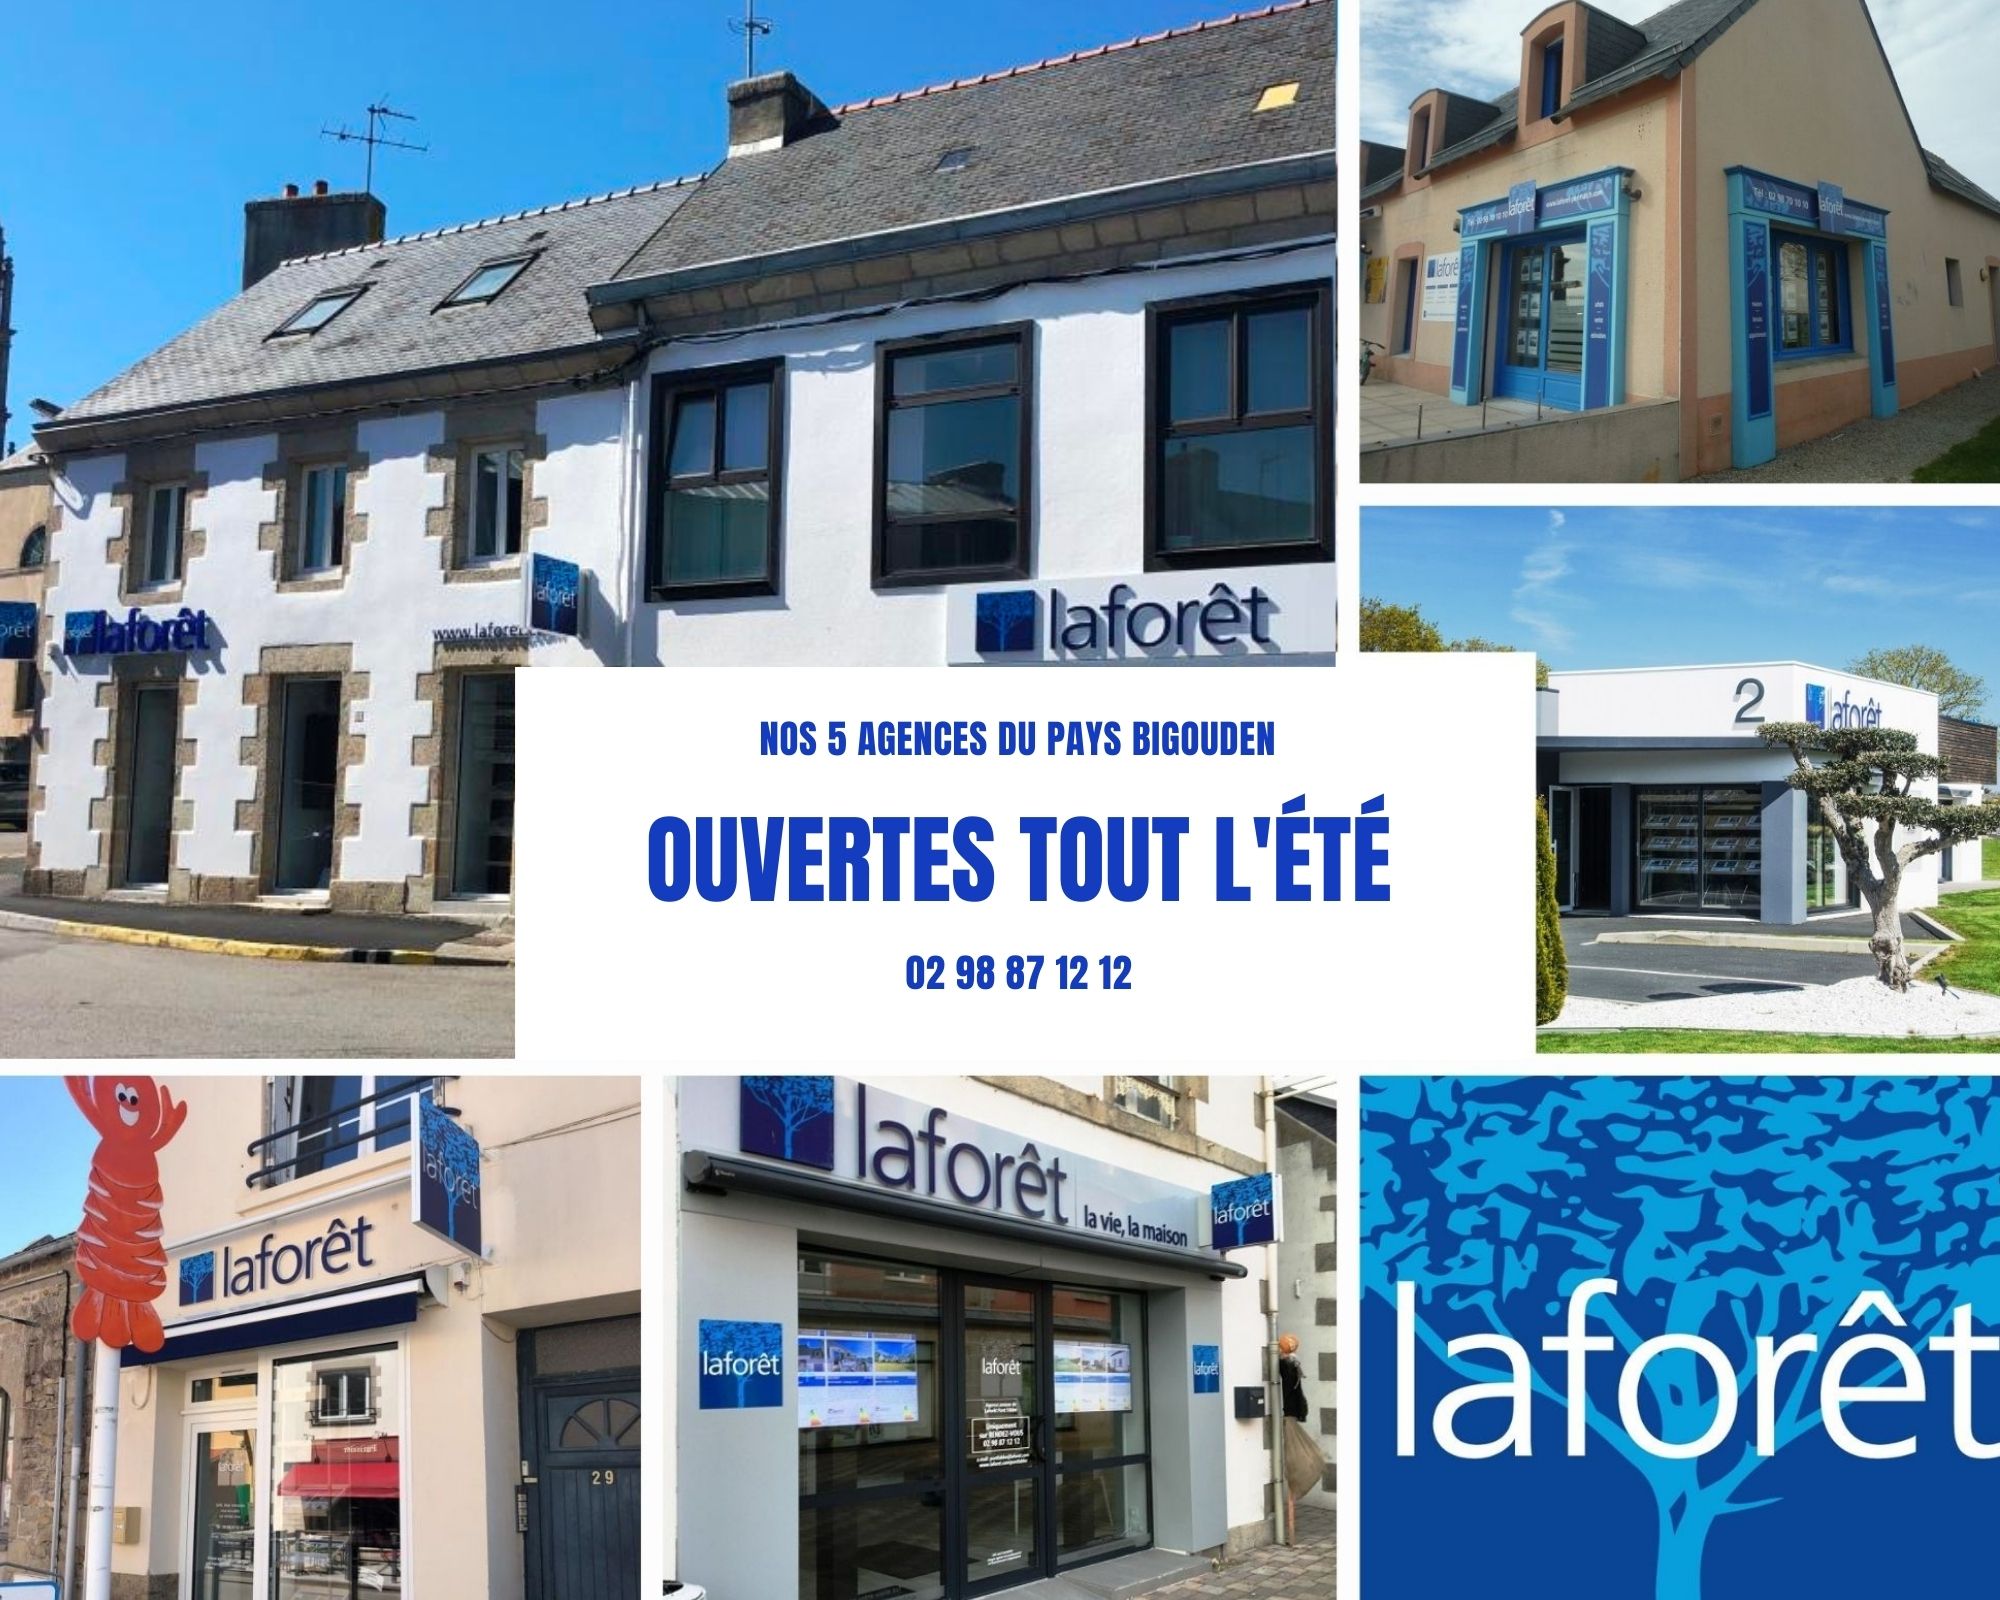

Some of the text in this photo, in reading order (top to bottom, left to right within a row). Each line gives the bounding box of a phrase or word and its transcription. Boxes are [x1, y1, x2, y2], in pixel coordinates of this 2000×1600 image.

[1508, 196, 1535, 217] laforêt
[1818, 195, 1844, 217] laforêt
[1050, 583, 1272, 650] laforêt
[95, 607, 210, 653] laforêt
[1734, 677, 1765, 723] 2
[858, 1082, 1069, 1225] laforêt
[1214, 1199, 1271, 1225] laforêt
[1084, 1204, 1188, 1247] la vie, la maison
[223, 1215, 374, 1297] laforêt
[703, 1350, 780, 1375] laforêt
[982, 1356, 1021, 1375] laforêt
[983, 1439, 990, 1447] 02
[592, 1470, 614, 1485] 29
